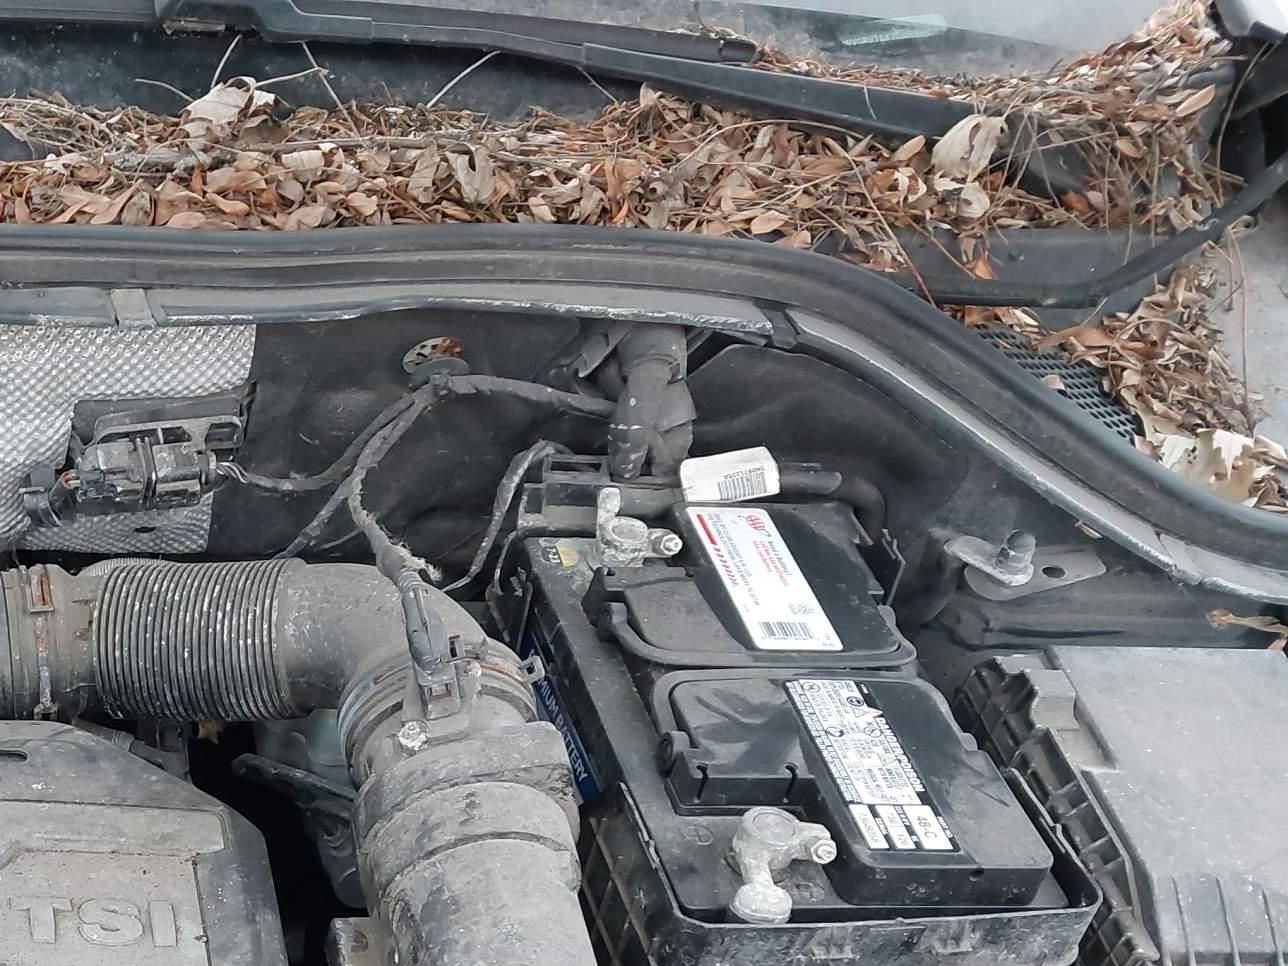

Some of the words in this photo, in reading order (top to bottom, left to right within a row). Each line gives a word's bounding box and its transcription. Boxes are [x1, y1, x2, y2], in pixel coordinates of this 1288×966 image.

[556, 711, 589, 783] BATTERY
[915, 815, 938, 839] 48-C
[12, 898, 178, 948] TSI
